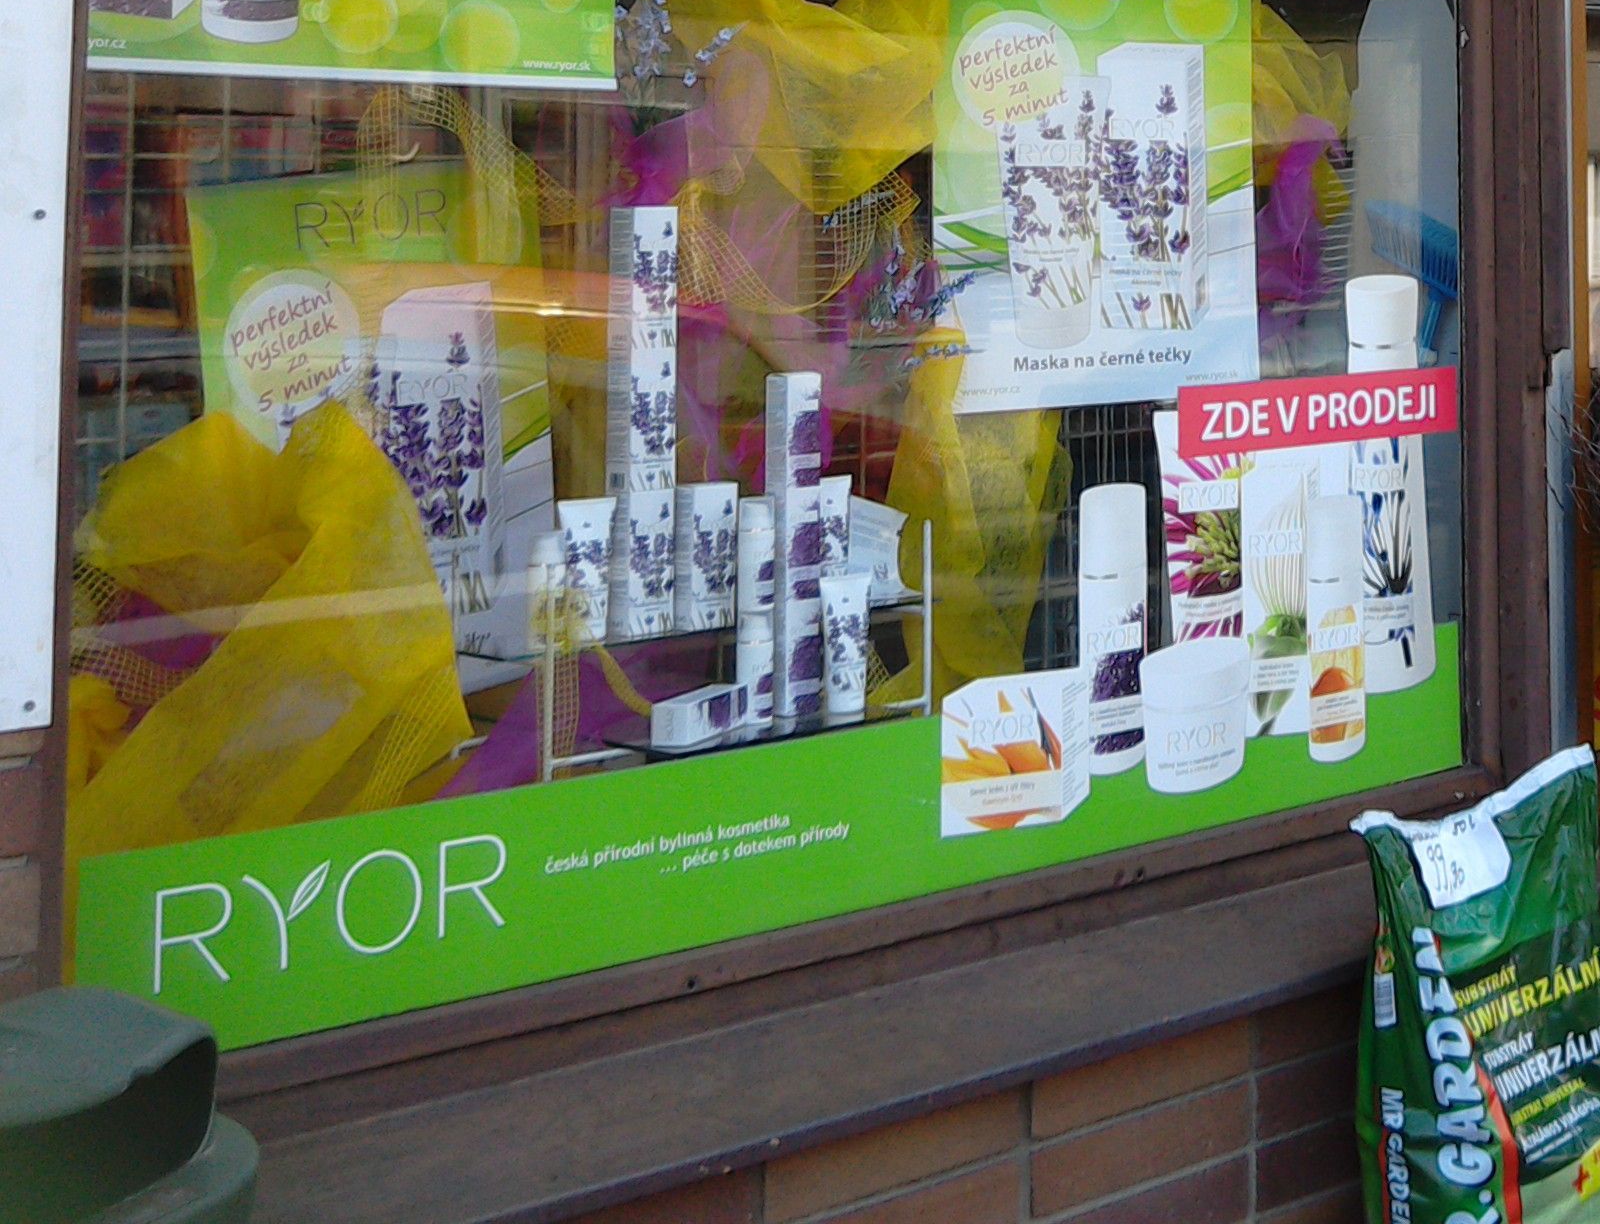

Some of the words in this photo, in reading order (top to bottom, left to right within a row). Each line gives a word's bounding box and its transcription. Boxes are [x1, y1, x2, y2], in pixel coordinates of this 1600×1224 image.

[87, 36, 127, 50] yor.cz
[959, 24, 1057, 76] perfektní
[969, 51, 1058, 92] výsledek
[1008, 80, 1029, 96] za
[982, 109, 996, 127] 5
[1005, 87, 1069, 120] minut
[1111, 118, 1175, 139] RYOR
[1016, 142, 1083, 164] RYOR
[294, 188, 447, 250] RYOR
[230, 280, 334, 357] perfektní
[243, 312, 338, 371] výsledek
[1013, 356, 1069, 374] Maska
[1074, 357, 1095, 369] na
[1099, 349, 1145, 367] černé
[1148, 346, 1192, 367] tečky
[258, 389, 274, 412] 5
[283, 354, 353, 401] minut
[286, 353, 310, 374] za
[1201, 398, 1270, 442] ZDE
[1276, 395, 1300, 434] V
[1307, 383, 1436, 432] PRODEJI
[1179, 483, 1236, 510] RYOR
[1353, 466, 1402, 487] RYOR
[1248, 531, 1300, 555] RYOR
[1086, 626, 1140, 654] RYOR
[1312, 626, 1360, 650] RYOR
[971, 714, 1034, 744] RYOR
[1166, 722, 1227, 755] RYOR
[544, 848, 589, 874] česká
[593, 836, 655, 869] přírodní
[659, 825, 713, 854] bylinná
[717, 813, 791, 841] kosmetika
[682, 845, 718, 872] péče
[722, 848, 730, 861] s
[733, 833, 796, 858] dotekem
[800, 821, 850, 849] přírody
[153, 832, 507, 996] RYOR
[1454, 964, 1518, 1008] SUBSTRÁT
[1483, 1031, 1535, 1072] SUBSTRÁT
[1381, 1087, 1404, 1129] MR
[1387, 1132, 1412, 1224] GARDE
